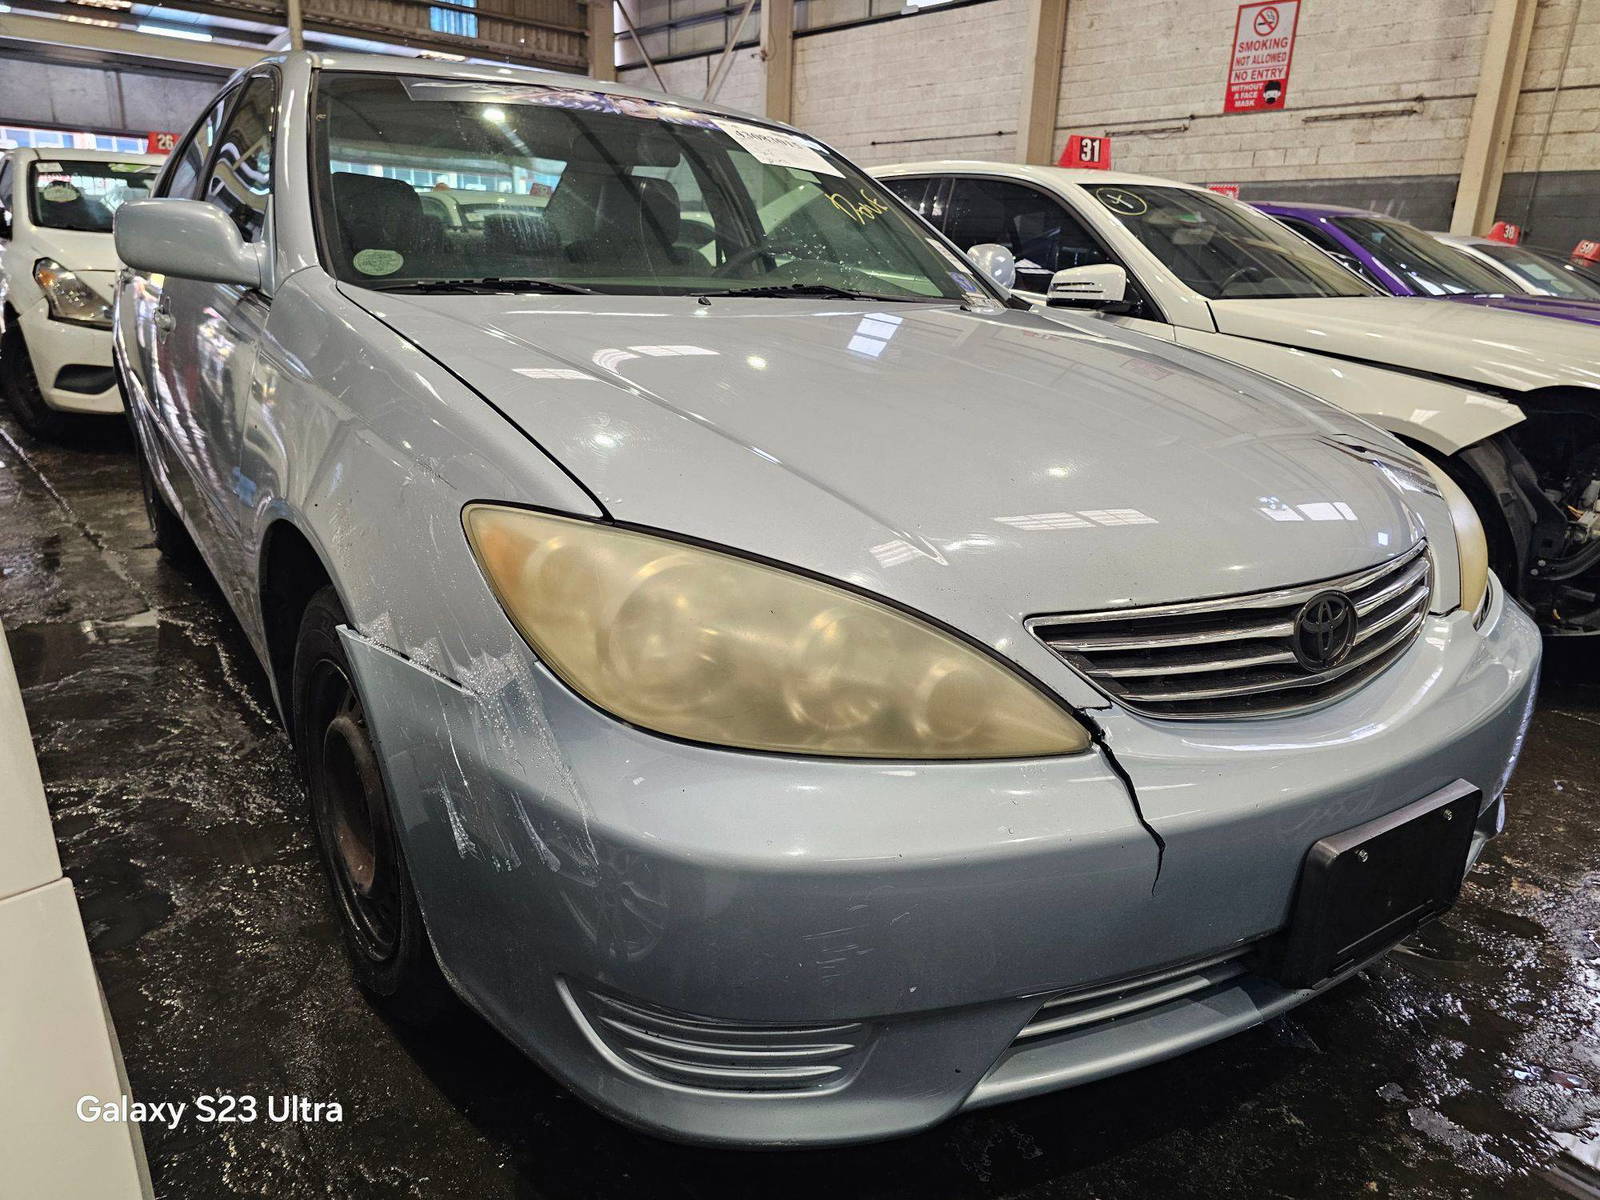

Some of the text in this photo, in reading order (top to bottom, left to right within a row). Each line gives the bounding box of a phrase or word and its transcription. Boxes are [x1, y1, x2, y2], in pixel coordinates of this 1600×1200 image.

[1238, 37, 1289, 53] SMOKING
[1236, 52, 1287, 66] NOT ALLOWED
[1234, 67, 1284, 81] NO ENTRY
[1231, 83, 1264, 92] WITHOUT
[1241, 91, 1258, 99] FACE
[157, 134, 174, 149] 26
[1081, 138, 1100, 162] 31
[1503, 225, 1515, 239] 38
